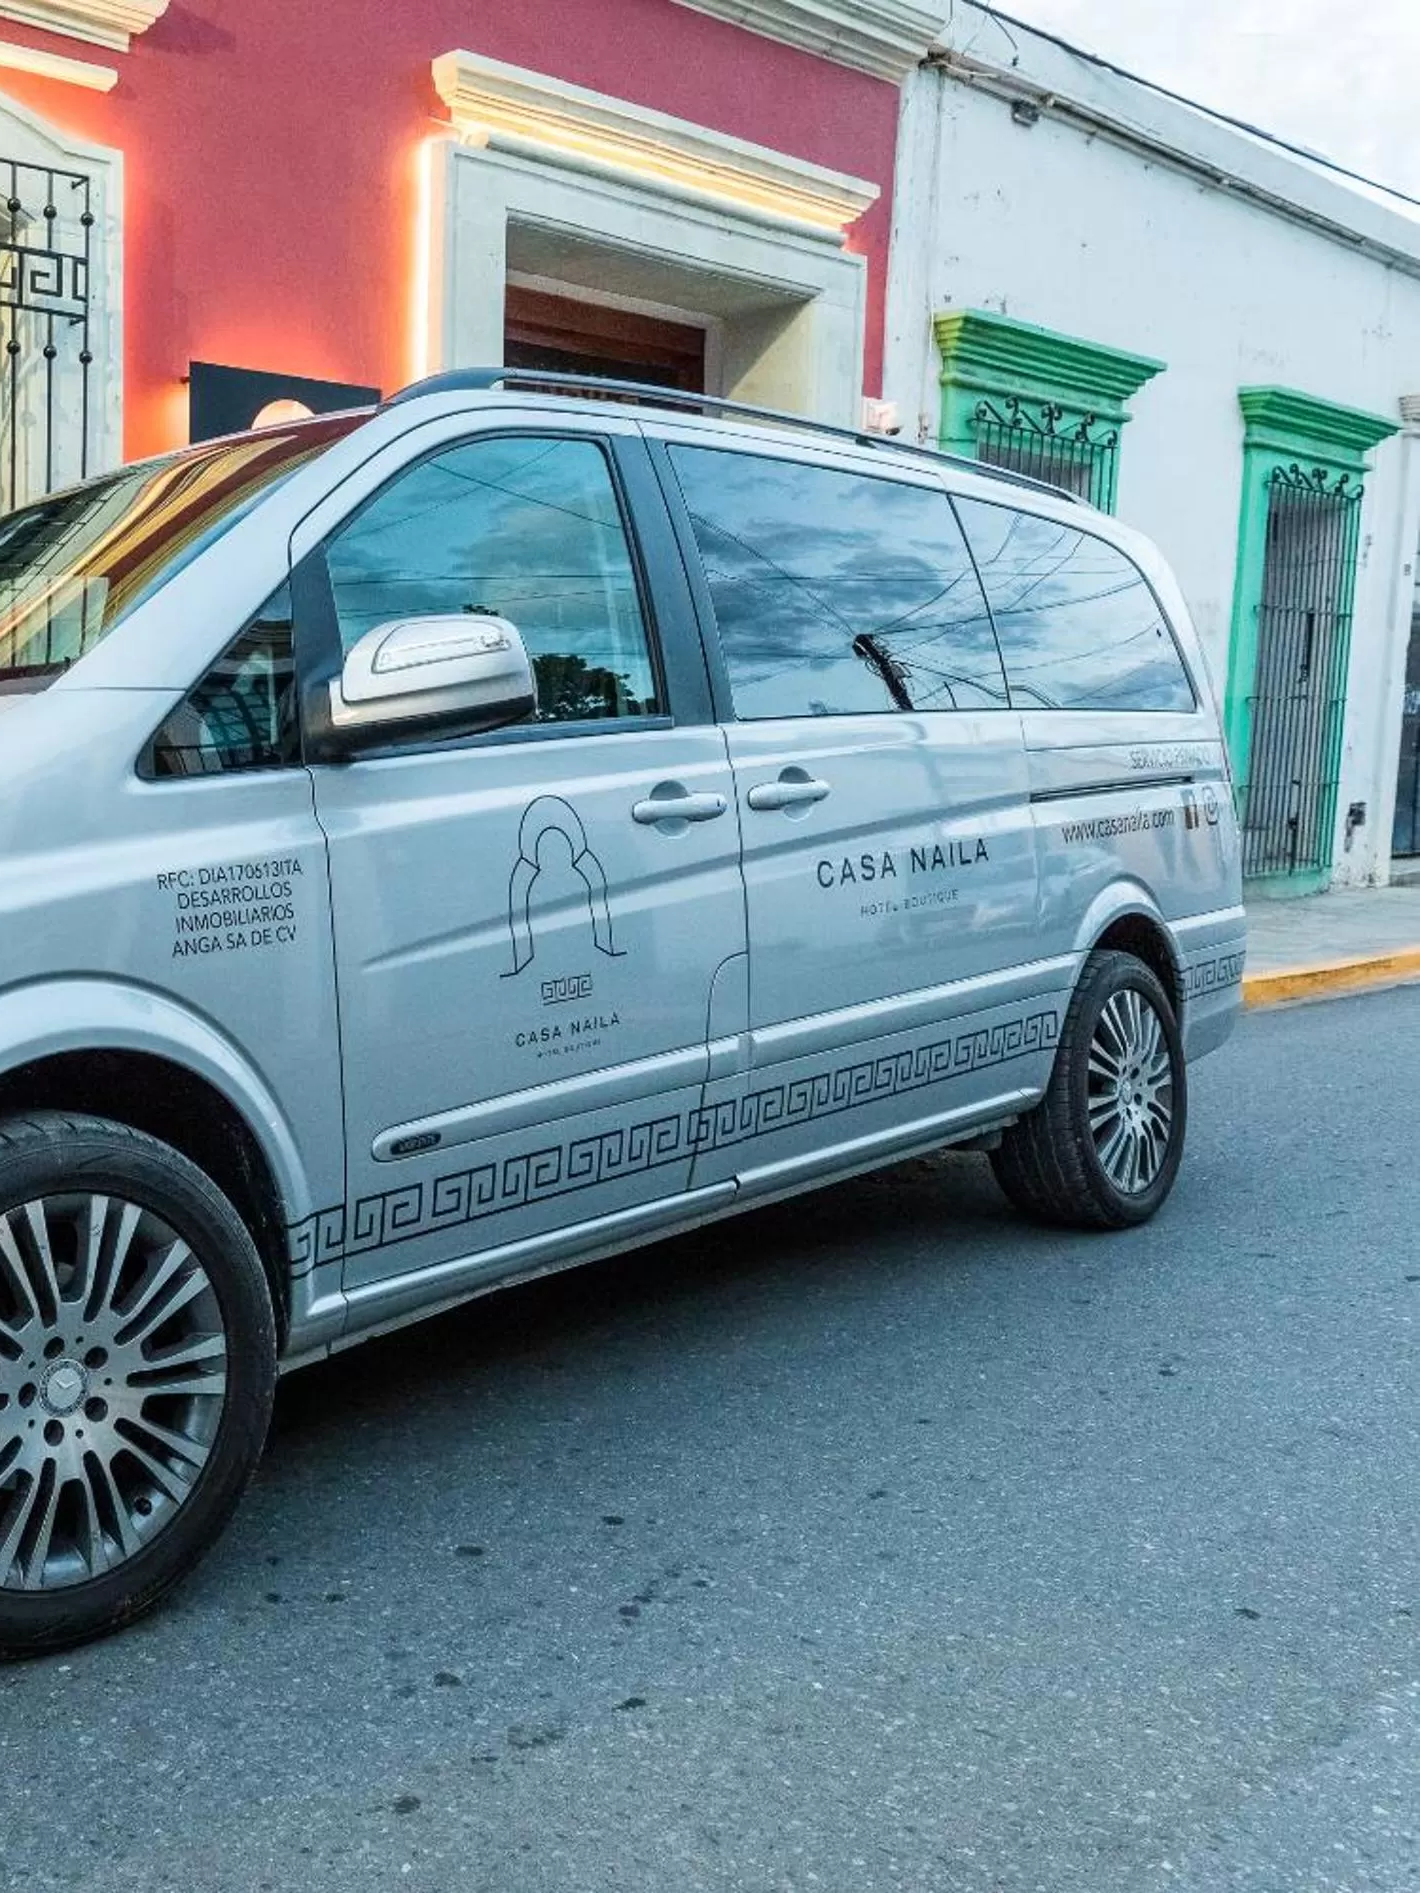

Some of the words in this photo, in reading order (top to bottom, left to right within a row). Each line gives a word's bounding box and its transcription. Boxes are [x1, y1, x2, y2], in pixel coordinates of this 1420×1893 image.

[1061, 807, 1175, 844] www.casanaila.com
[817, 851, 897, 888] CASA
[909, 838, 989, 874] NAILA
[157, 870, 194, 890] RFC:
[177, 881, 293, 910] DESARROLLOS
[175, 902, 295, 934] INMOBILIARIOS
[172, 936, 222, 958] ANGA
[226, 932, 248, 950] SA
[251, 928, 273, 946] DE
[276, 925, 297, 944] CV
[515, 1025, 562, 1048] CASA
[571, 1011, 621, 1035] NAILA
